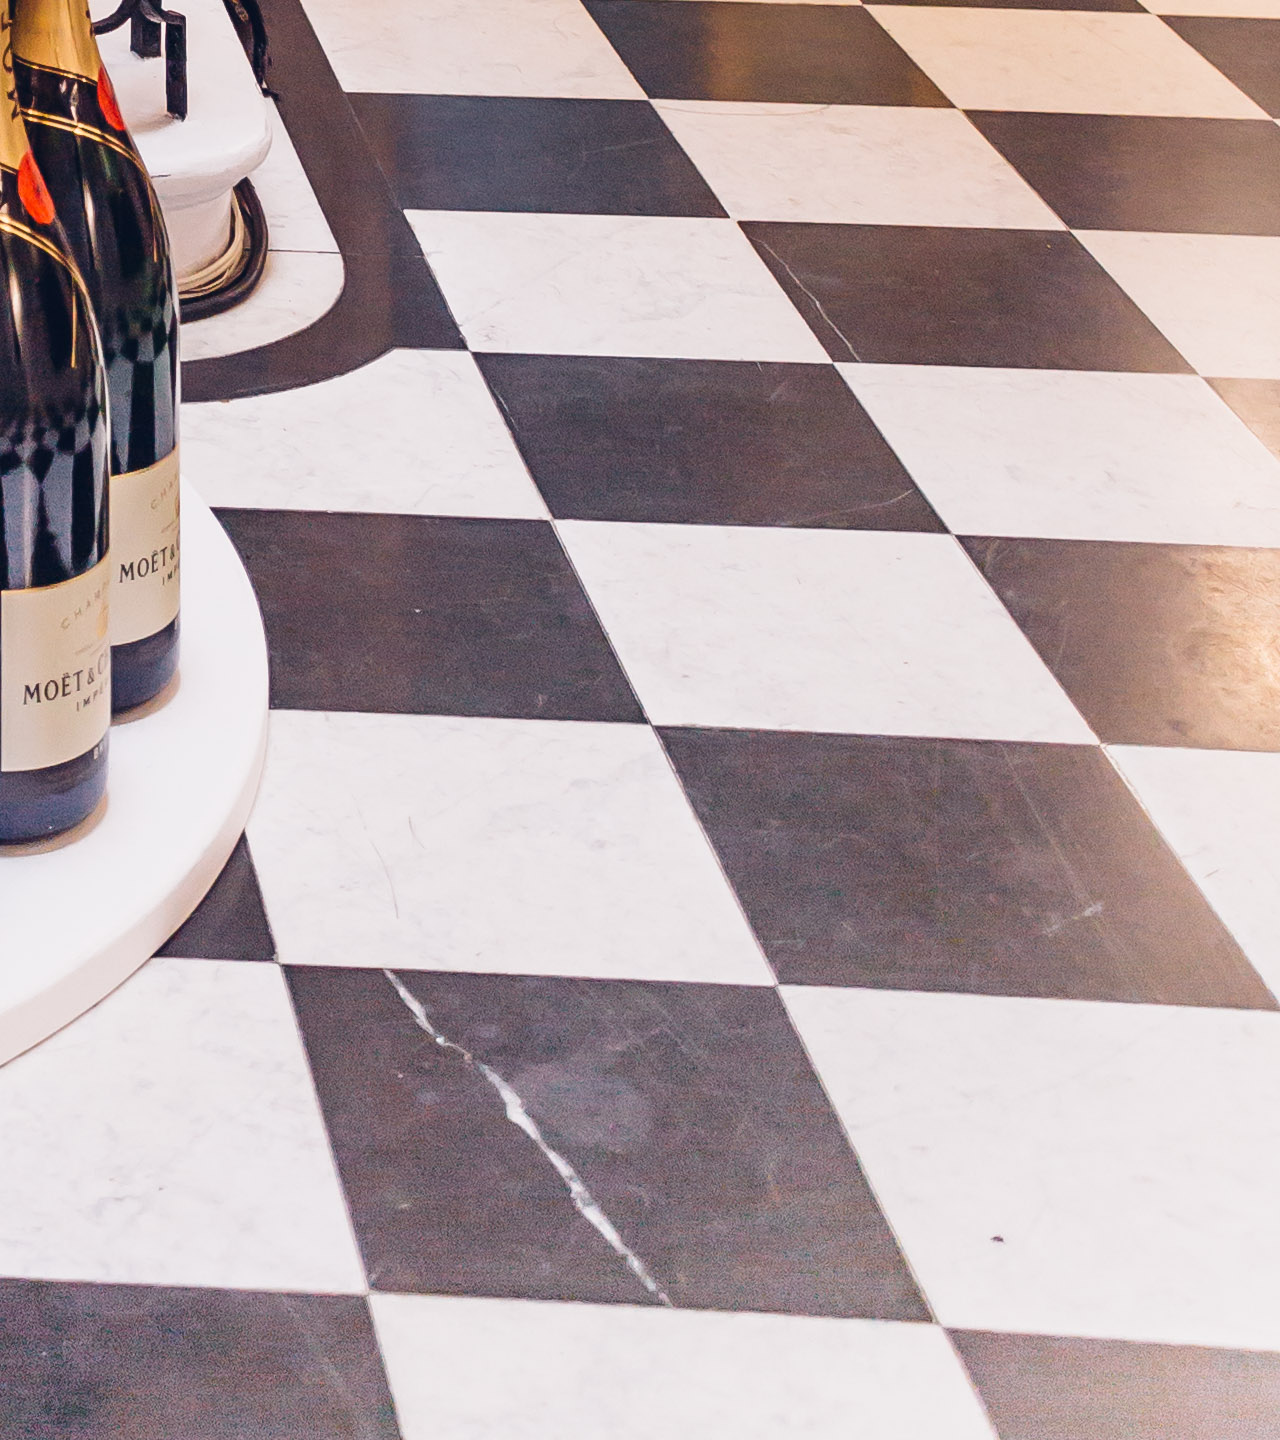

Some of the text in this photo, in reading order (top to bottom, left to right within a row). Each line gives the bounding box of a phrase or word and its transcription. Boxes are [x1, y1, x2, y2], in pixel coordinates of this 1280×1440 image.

[119, 546, 168, 583] MOËT
[23, 670, 84, 706] MOËT
[87, 667, 96, 684] &
